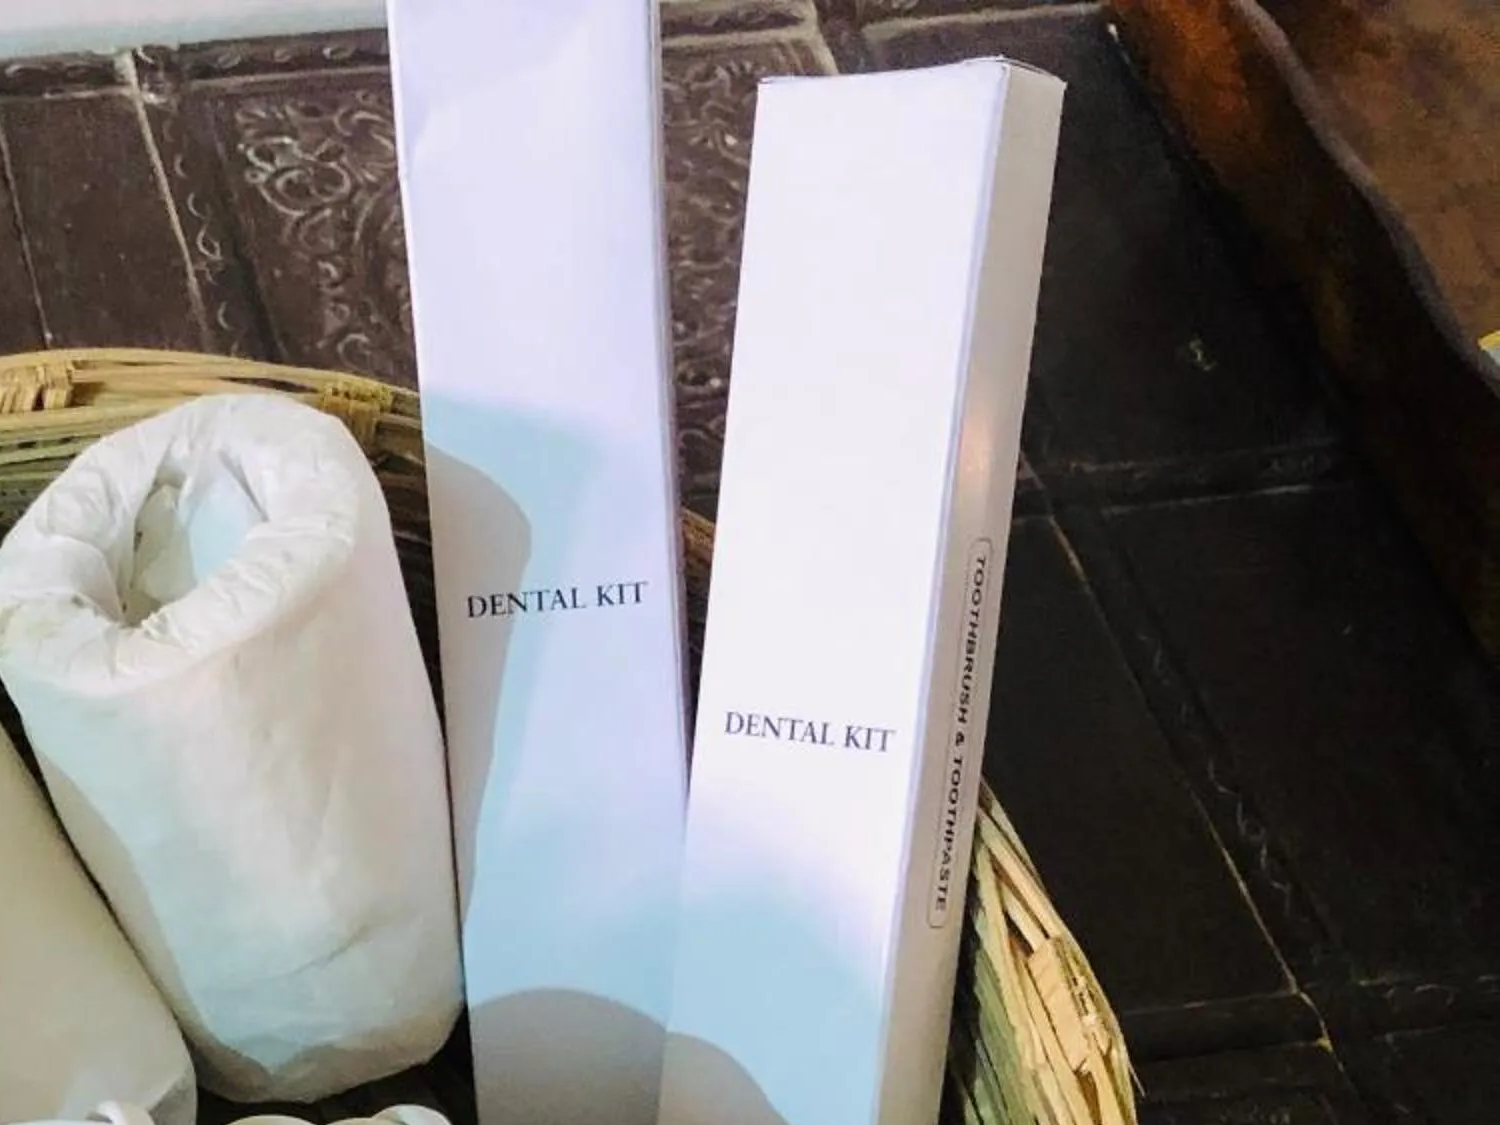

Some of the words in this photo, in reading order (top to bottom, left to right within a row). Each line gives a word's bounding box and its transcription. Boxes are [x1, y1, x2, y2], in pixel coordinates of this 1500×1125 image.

[467, 587, 587, 618] DENTAL
[596, 581, 649, 606] KIT
[957, 556, 986, 723] TOOTHBRUSH
[724, 711, 835, 746] DENTAL
[844, 725, 897, 753] KIT
[954, 731, 965, 747] &
[936, 757, 962, 911] TOOTHPASTE
